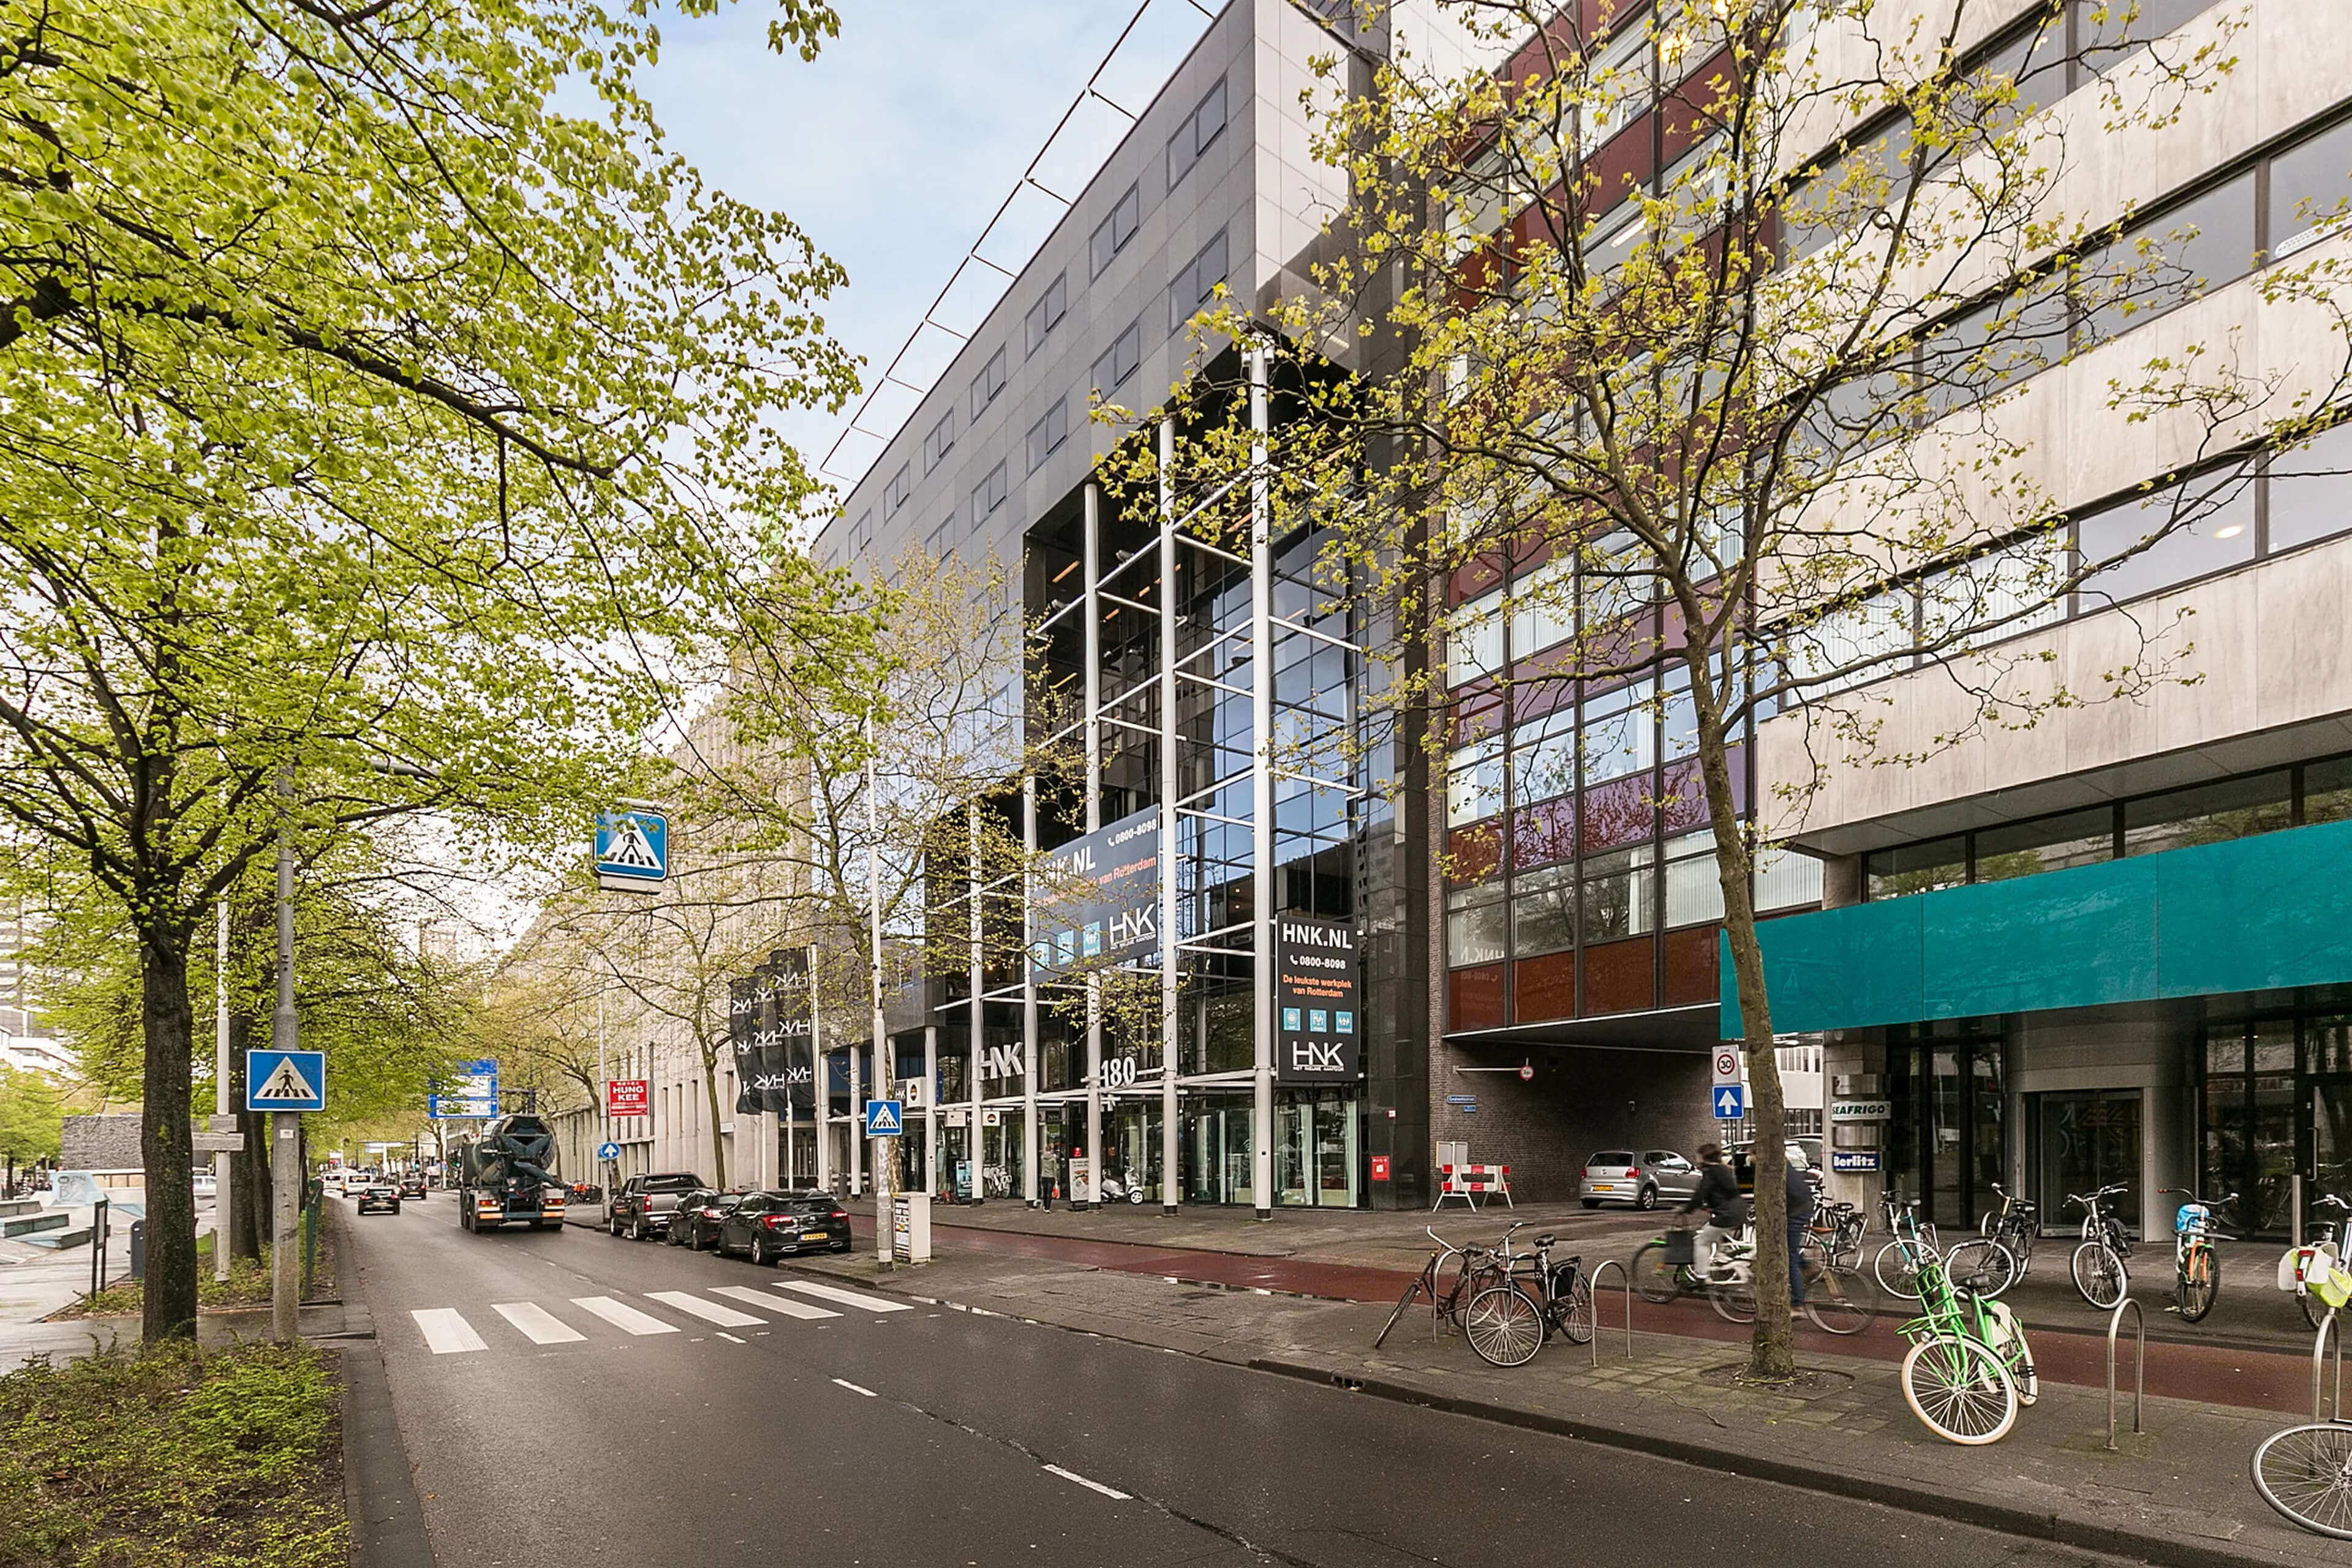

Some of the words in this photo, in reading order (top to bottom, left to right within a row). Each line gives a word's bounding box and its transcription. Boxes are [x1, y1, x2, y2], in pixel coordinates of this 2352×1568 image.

[1115, 818, 1157, 845] 0800-8098
[1099, 872, 1112, 884] van
[1114, 857, 1156, 880] Rotterdam
[1109, 903, 1156, 946] HNK
[1283, 923, 1352, 949] HNK.NL
[1299, 956, 1346, 970] 0800-8098
[1283, 974, 1293, 984] De
[1294, 976, 1319, 986] leukste
[1321, 979, 1352, 989] werkplek
[1306, 987, 1344, 998] Rotterdam
[979, 1042, 1025, 1081] HNK
[1293, 1041, 1344, 1066] HNK
[1721, 1060, 1732, 1069] 30
[1101, 1057, 1137, 1088] 180
[1832, 1105, 1885, 1115] SEAFRIGO
[1833, 1155, 1876, 1167] Berlitz
